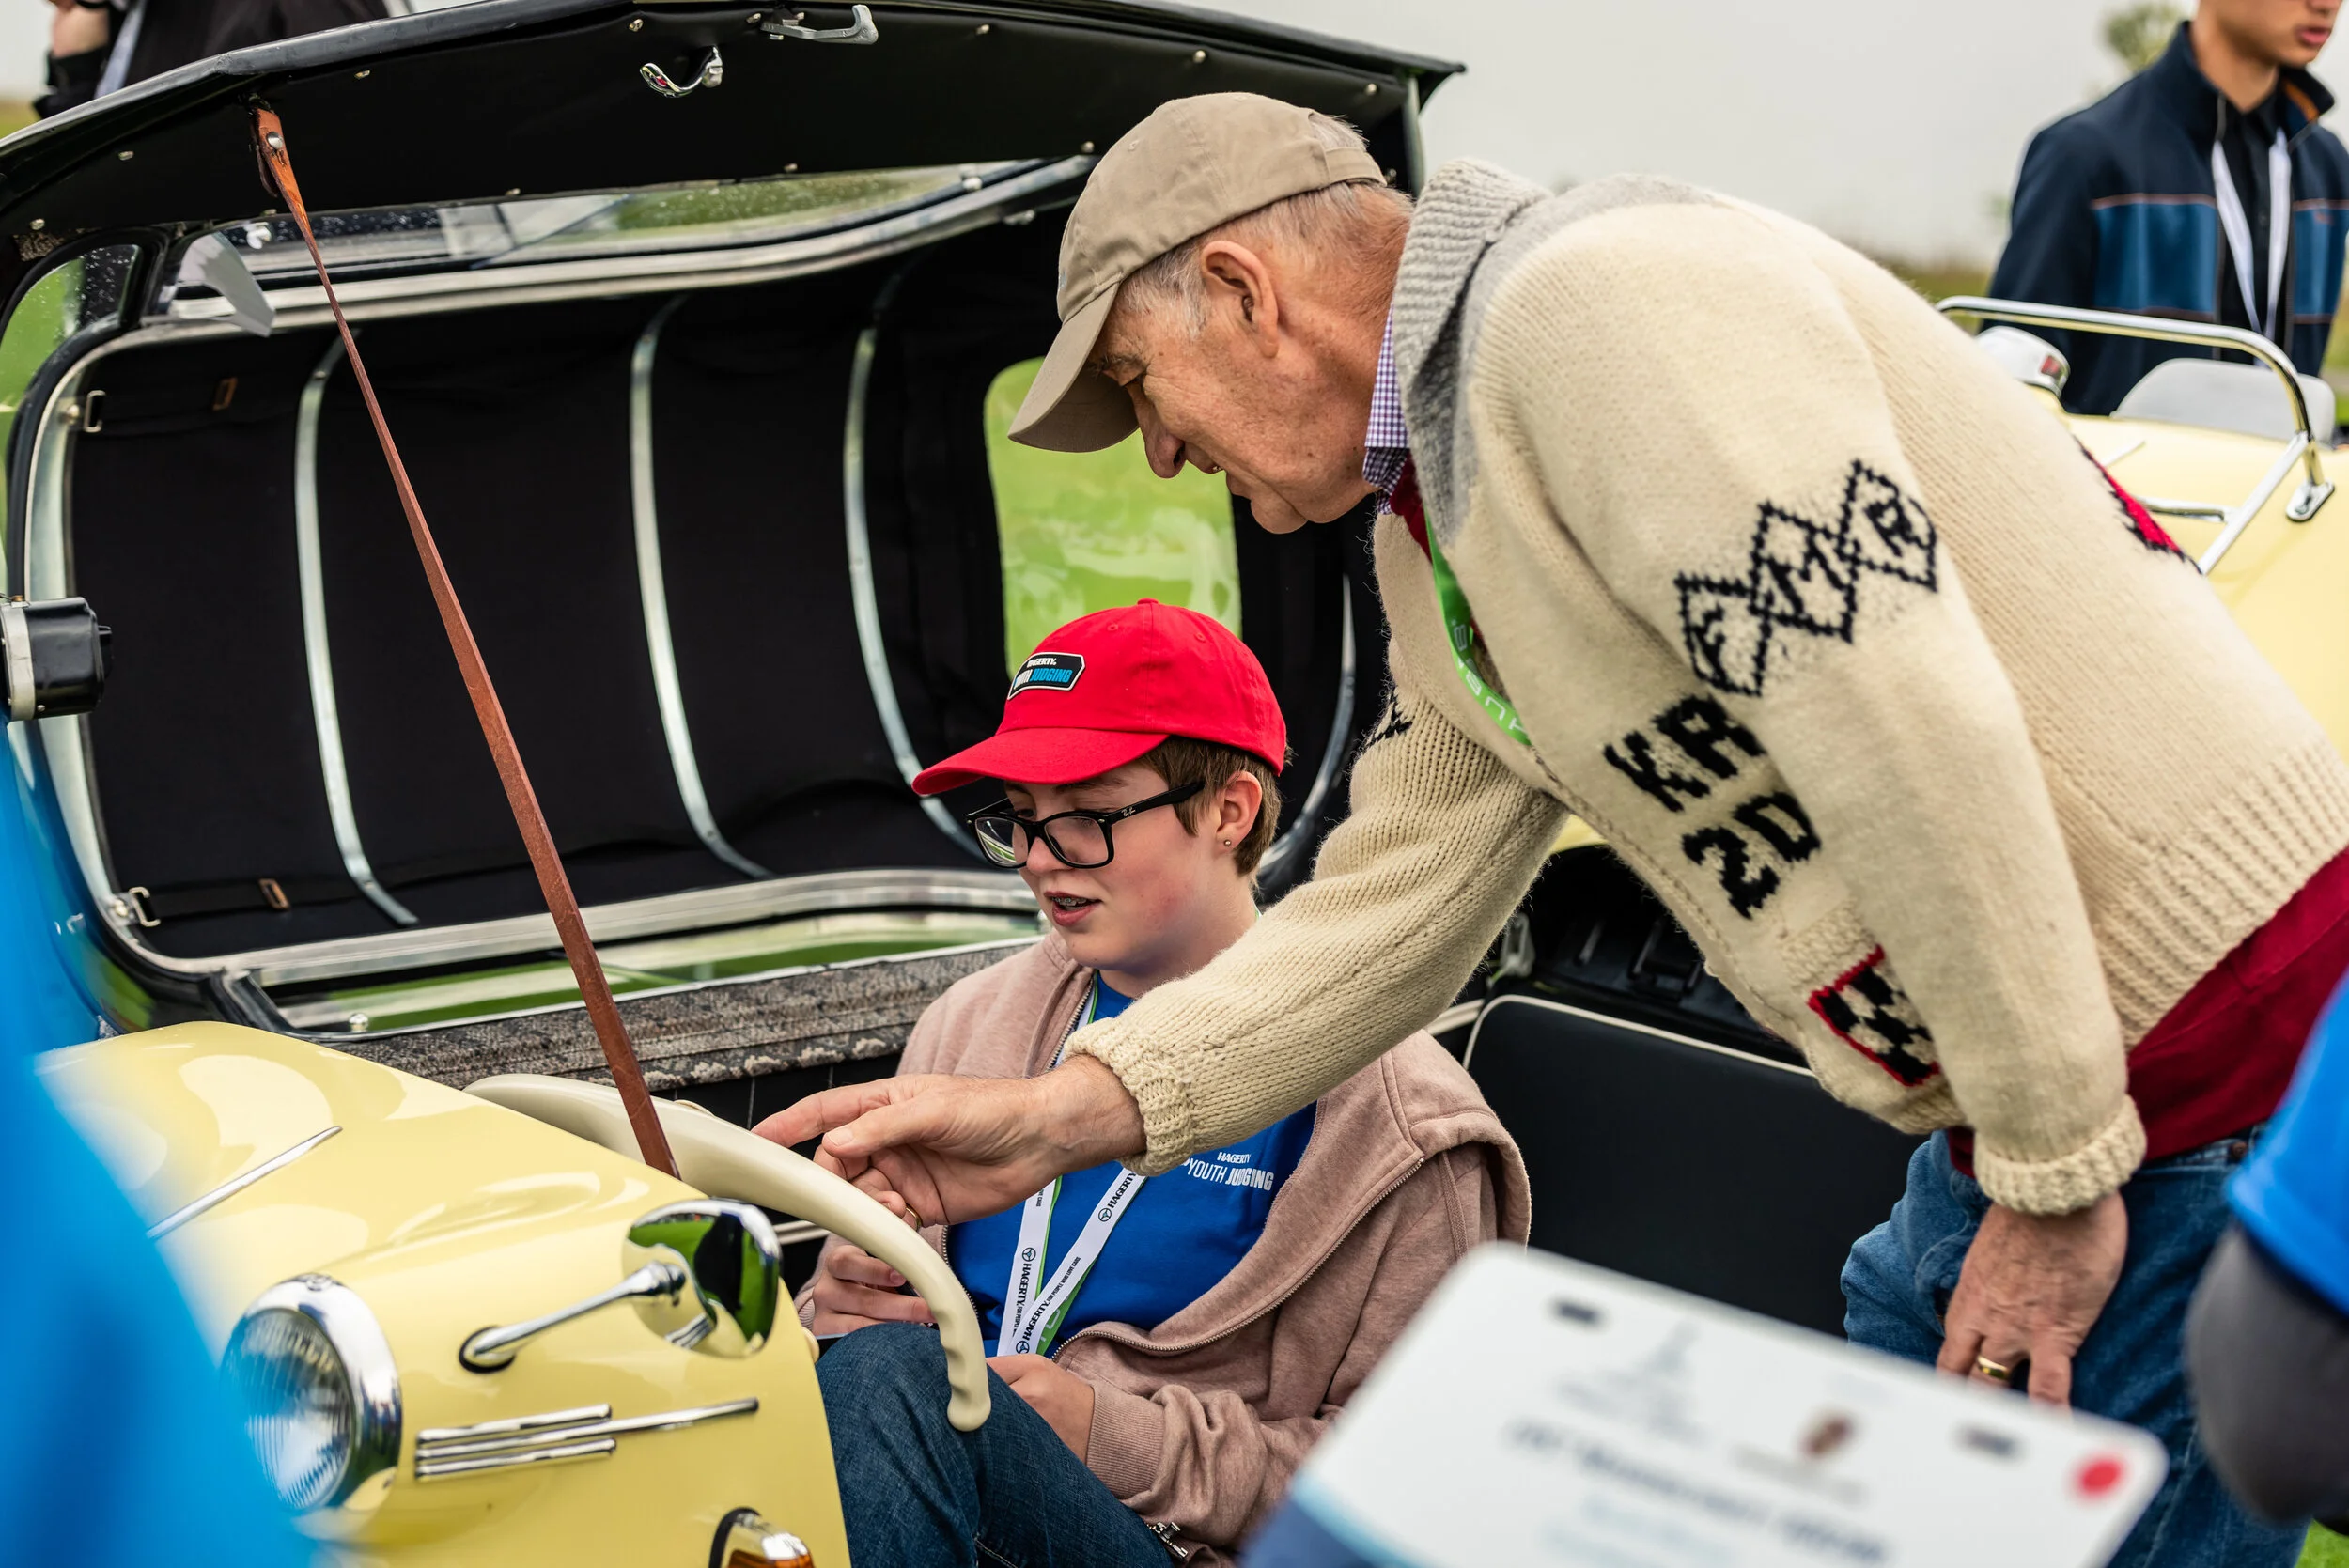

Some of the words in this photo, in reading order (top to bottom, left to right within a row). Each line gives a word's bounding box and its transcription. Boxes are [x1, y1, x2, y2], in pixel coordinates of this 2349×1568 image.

[1029, 668, 1073, 683] JUDGING
[1602, 693, 1769, 814] KR
[1217, 1152, 1252, 1164] HAGERTY
[1188, 1157, 1228, 1183] YOUTH
[1051, 1283, 1064, 1296] PEOPLE
